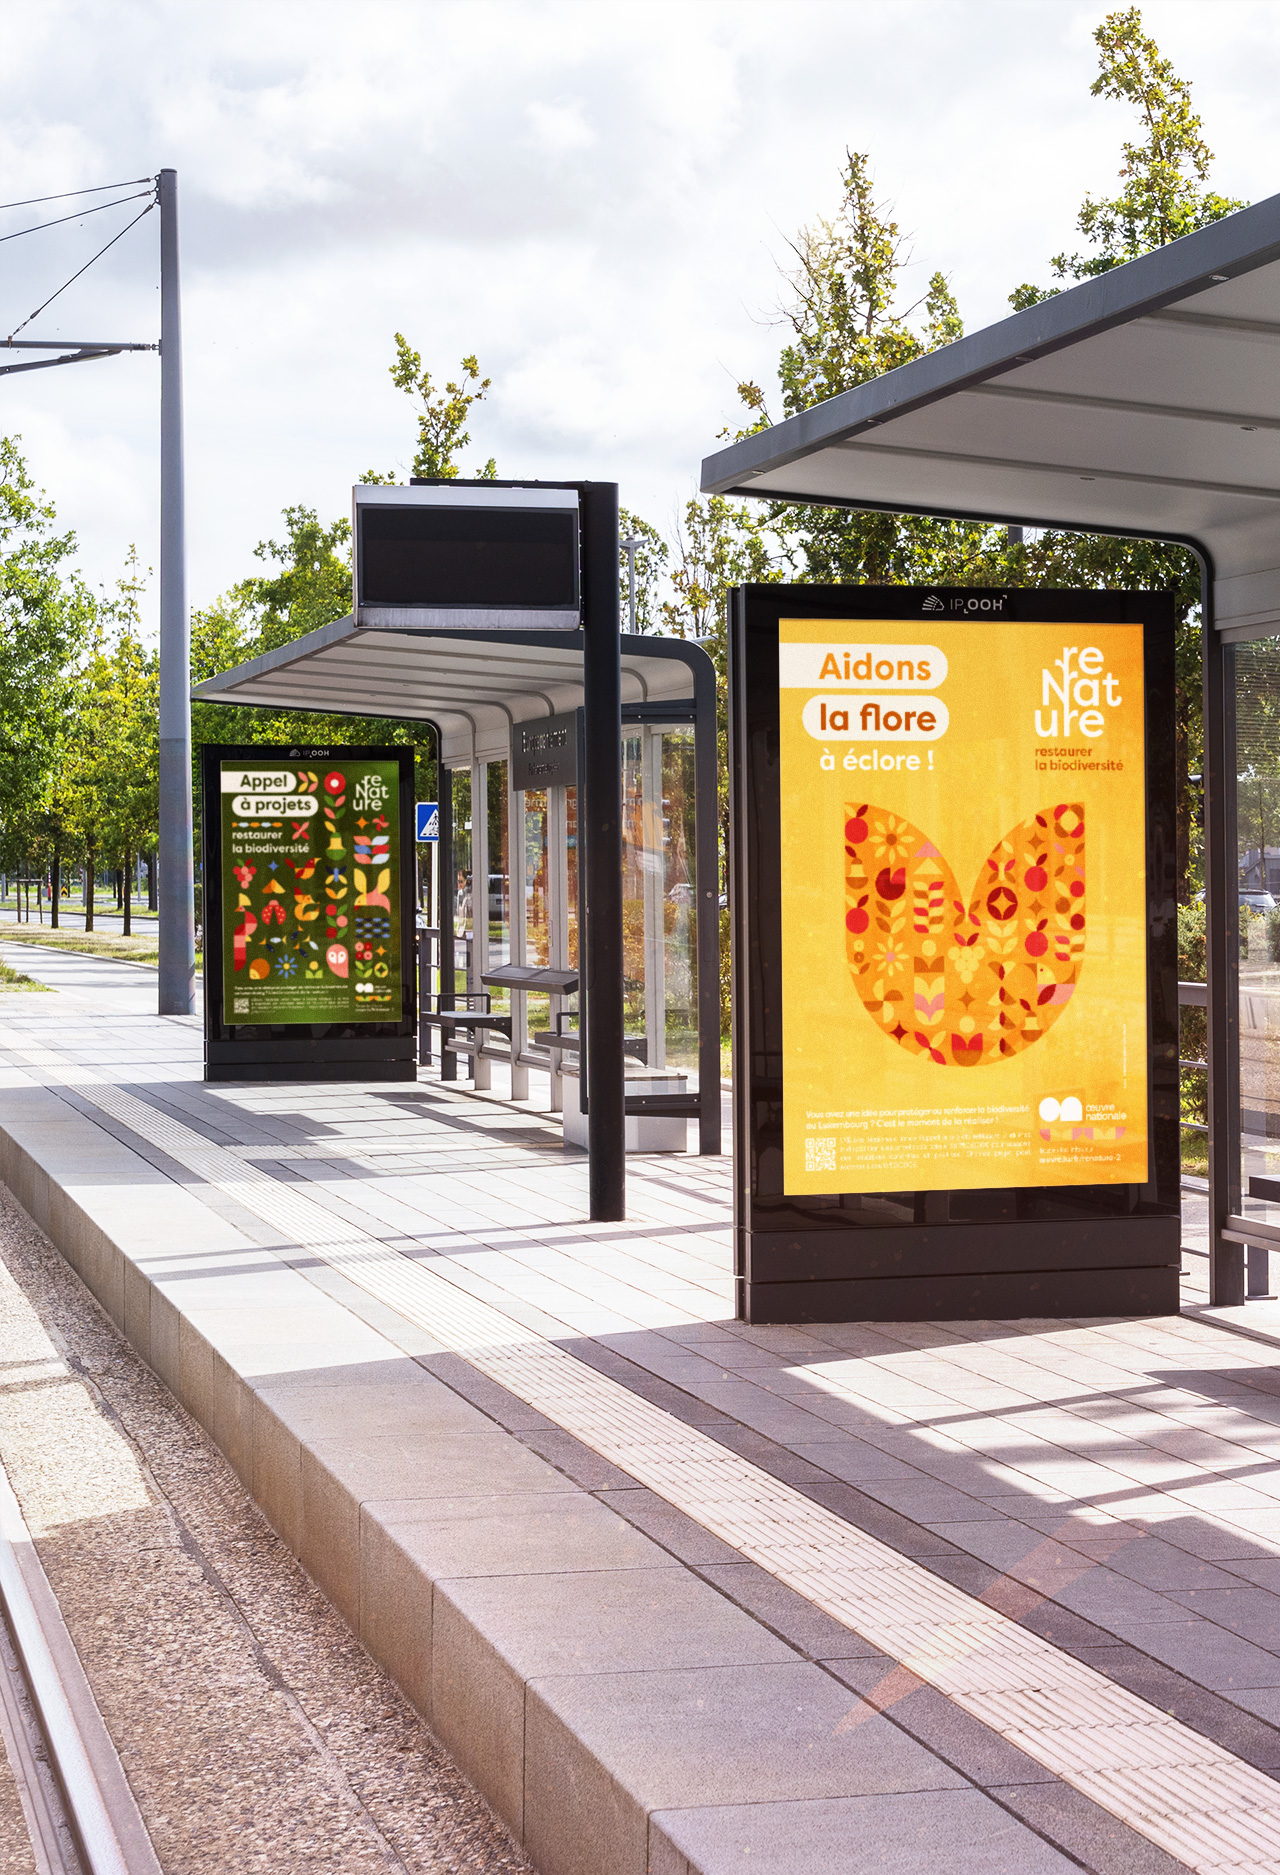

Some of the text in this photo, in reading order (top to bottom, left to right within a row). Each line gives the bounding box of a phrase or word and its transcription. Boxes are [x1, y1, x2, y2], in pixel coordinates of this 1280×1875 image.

[818, 652, 932, 681] Aidons
[819, 703, 937, 732] la flore
[819, 747, 835, 771] à
[842, 747, 921, 771] éclore
[1034, 746, 1093, 758] restaurer
[1034, 758, 1124, 772] la biodiversité
[240, 774, 288, 791] Appel
[240, 797, 312, 814] à projets
[232, 831, 283, 840] restaurer
[232, 843, 310, 854] la biodiversité
[1085, 1111, 1127, 1121] nationale
[818, 1121, 868, 1130] Luxembourg
